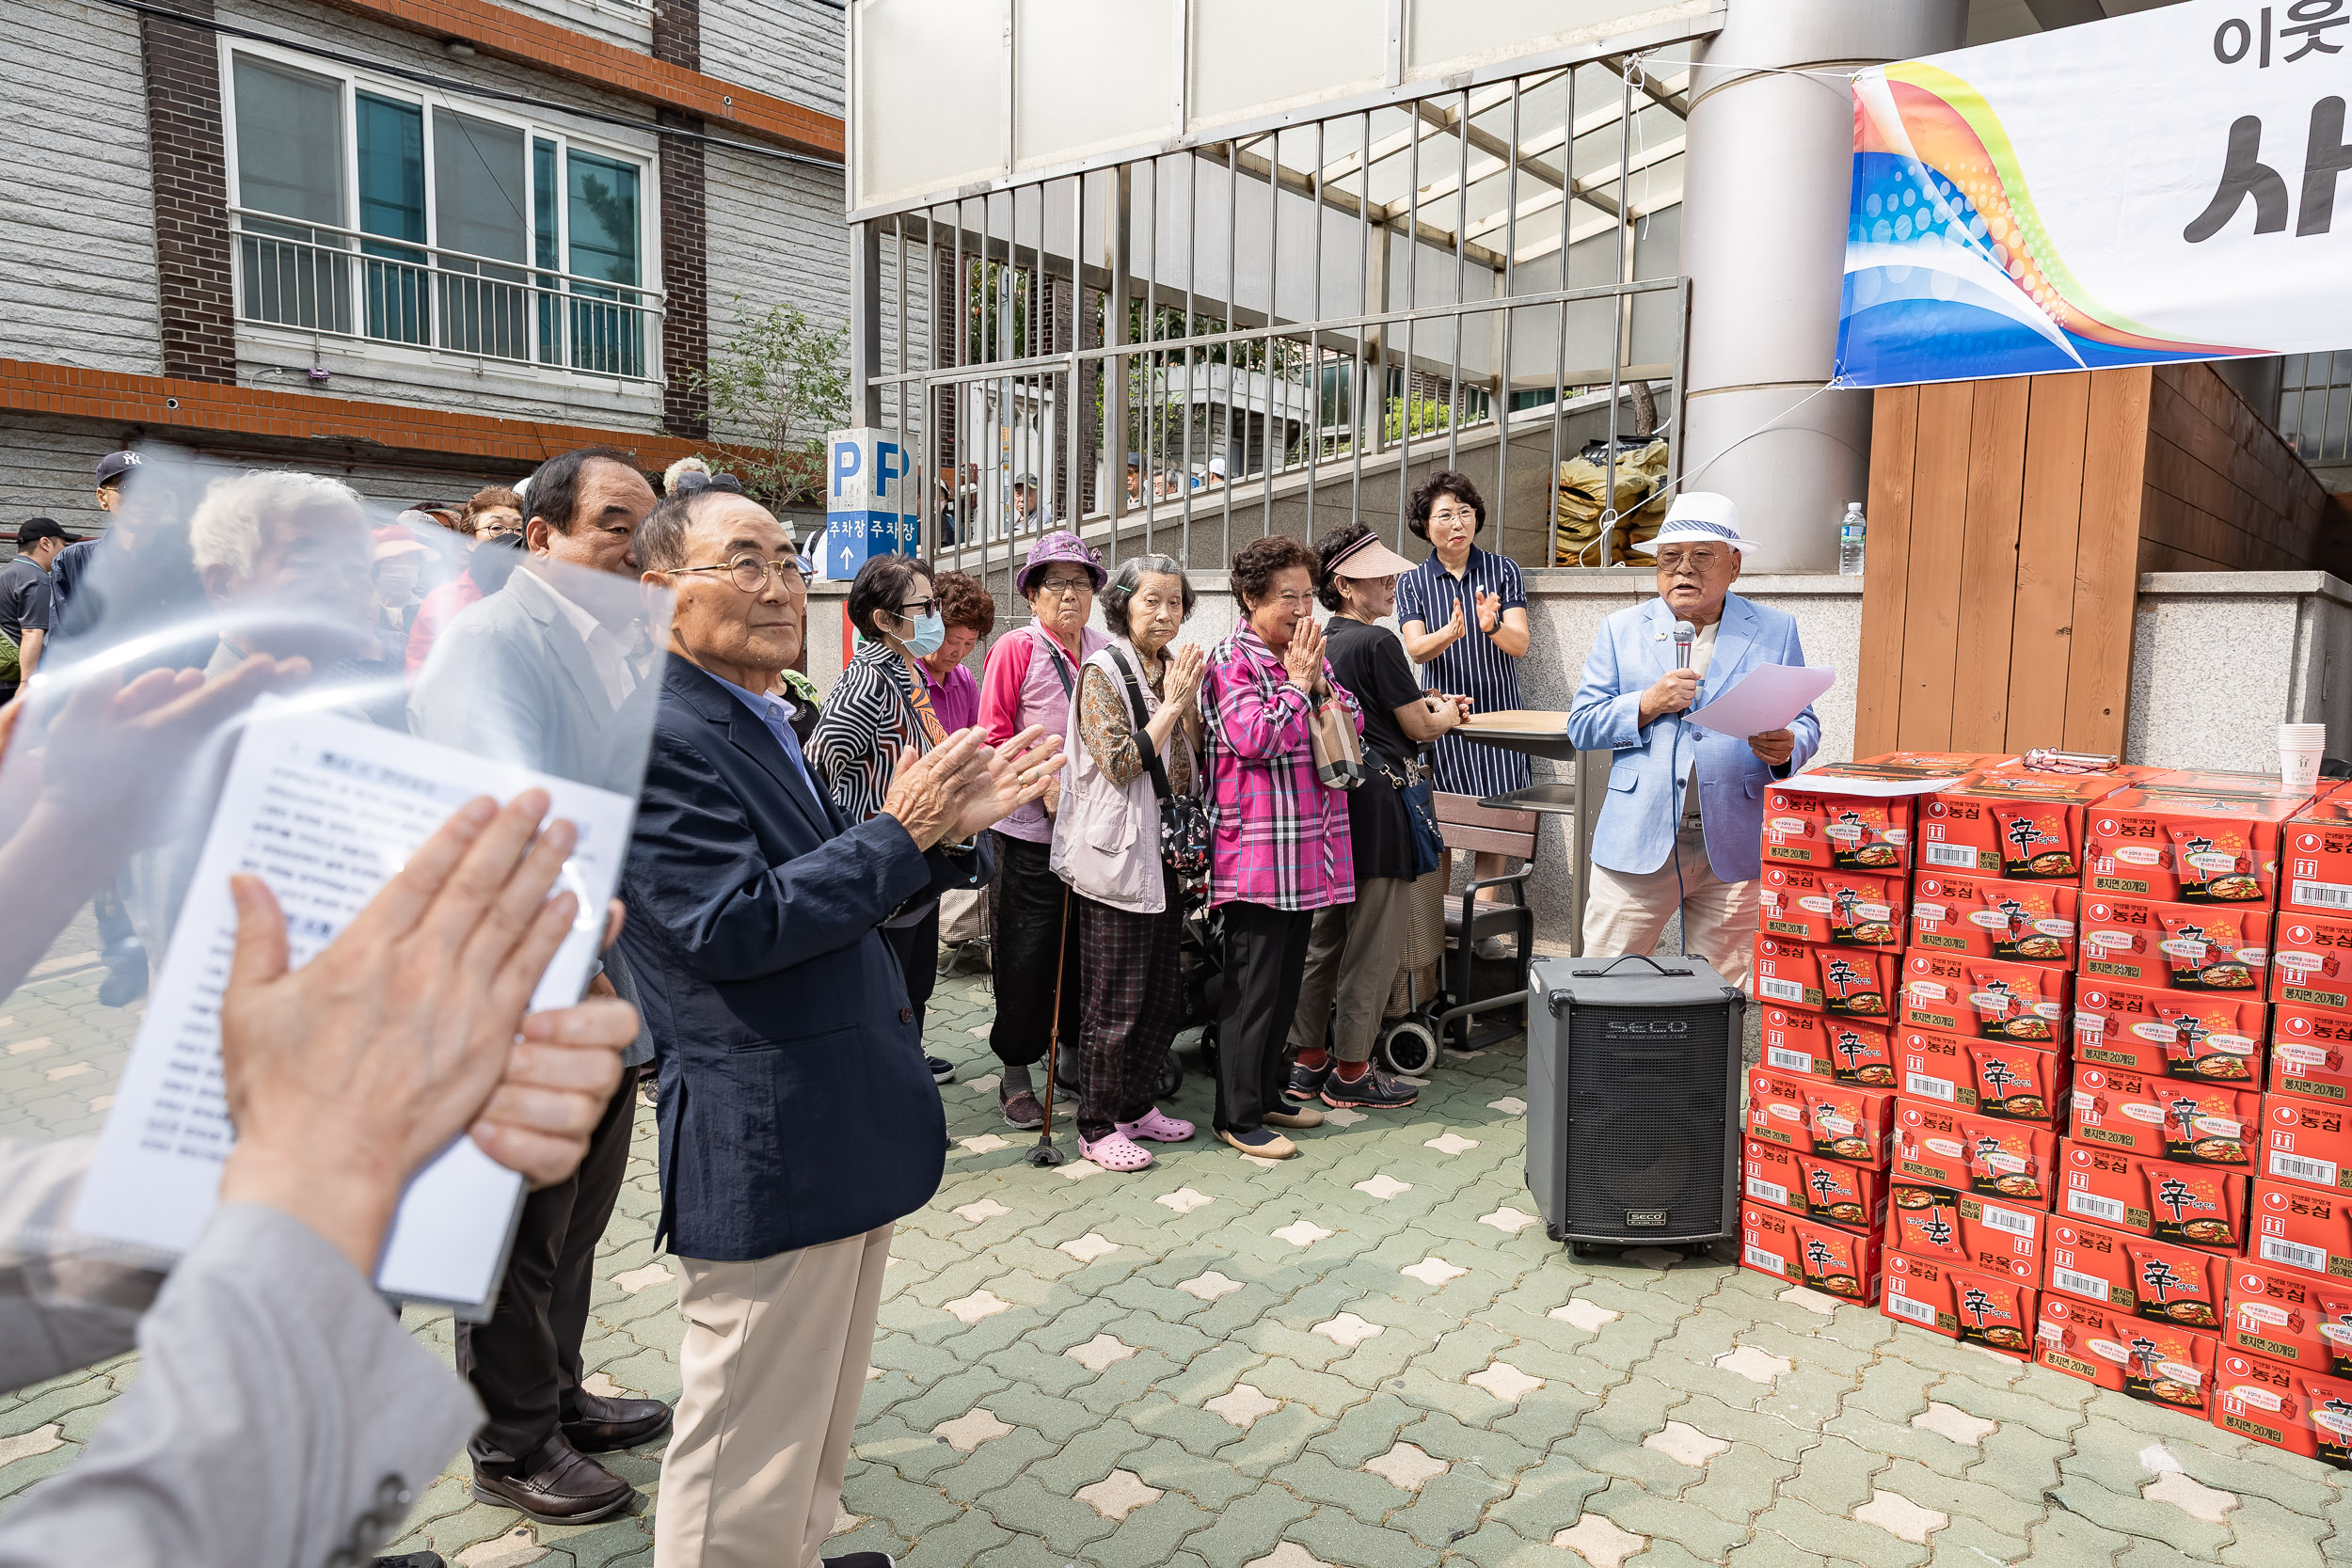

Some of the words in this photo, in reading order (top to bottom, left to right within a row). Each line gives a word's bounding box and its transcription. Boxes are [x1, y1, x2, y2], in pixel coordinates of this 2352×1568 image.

[2214, 0, 2350, 69] 이웃
[2184, 95, 2352, 244] 사
[122, 452, 143, 466] NY
[834, 442, 862, 497] P
[877, 441, 910, 497] P
[829, 519, 866, 539] 주차장
[870, 520, 915, 542] 주차장
[1789, 800, 1816, 812] 농심
[1949, 807, 1979, 819] 농심
[2009, 817, 2042, 859] 辛
[2121, 824, 2155, 837] 농심
[1790, 850, 1810, 861] 20개입
[1980, 852, 1999, 861] 봉지면
[1979, 862, 1999, 870] 20개입
[1788, 875, 1813, 887] 농심
[2096, 878, 2119, 889] 봉지면
[2122, 881, 2147, 893] 20개입
[1943, 886, 1972, 898] 농심
[2113, 910, 2147, 924] 농심
[1922, 935, 1941, 944] 봉지면
[1944, 938, 1964, 949] 20개입
[1778, 946, 1804, 958] 농심
[1931, 964, 1961, 978] 농심
[2090, 962, 2111, 974] 봉지면
[1829, 959, 1857, 996] 辛
[1805, 997, 1821, 1006] 20개입
[2286, 988, 2312, 1001] 봉지면
[2314, 992, 2344, 1006] 20개입
[2108, 998, 2142, 1013] 농심
[1788, 1017, 1813, 1030] 농심
[1912, 1011, 1931, 1022] 봉지면
[1932, 1016, 1954, 1028] 20개입
[1838, 1031, 1867, 1068] 辛
[1928, 1041, 1956, 1055] 농심
[2085, 1049, 2107, 1061] 봉지면
[2110, 1053, 2135, 1066] 20개입
[1814, 1068, 1830, 1076] 20개입
[1983, 1059, 2015, 1098] 辛
[1772, 1085, 1796, 1099] 농심
[1957, 1088, 1975, 1097] 봉지면
[2107, 1078, 2141, 1094] 농심
[2285, 1079, 2311, 1091] 봉지면
[2314, 1085, 2344, 1099] 20개입
[1956, 1096, 1975, 1105] 20개입
[1924, 1117, 1952, 1132] 농심
[2300, 1114, 2341, 1132] 농심
[1772, 1131, 1791, 1144] 20개입
[2084, 1128, 2106, 1140] 봉지면
[2108, 1132, 2133, 1146] 20개입
[1764, 1150, 1788, 1164] 농심
[1903, 1163, 1922, 1173] 봉지면
[1924, 1167, 1946, 1180] 20개입
[2094, 1157, 2127, 1174] 농심
[1812, 1169, 1838, 1204] 辛
[1789, 1200, 1805, 1210] 20개입
[2160, 1179, 2197, 1221] 辛
[2127, 1207, 2149, 1217] 봉지면
[2291, 1200, 2329, 1219] 농심
[1762, 1218, 1785, 1233] 농심
[2127, 1216, 2148, 1228] 20개입
[2078, 1235, 2111, 1253] 농심
[1808, 1240, 1833, 1275] 辛
[1979, 1252, 2010, 1269] 농심
[1787, 1271, 1802, 1280] 20개입
[1909, 1265, 1937, 1281] 농심
[2143, 1259, 2180, 1302] 辛
[2111, 1287, 2133, 1297] 봉지면
[2266, 1283, 2305, 1304] 농심
[1964, 1288, 1995, 1326] 辛
[2111, 1295, 2133, 1307] 20개입
[1938, 1311, 1956, 1323] 봉지면
[2070, 1310, 2102, 1329] 농심
[1937, 1321, 1956, 1332] 20개입
[2240, 1334, 2265, 1350] 봉지면
[2268, 1341, 2296, 1358] 20개입
[2048, 1352, 2070, 1368] 봉지면
[2072, 1360, 2096, 1377] 20개입
[2252, 1367, 2289, 1388] 농심
[2226, 1416, 2250, 1432] 봉지면
[2253, 1425, 2281, 1442] 20개입
